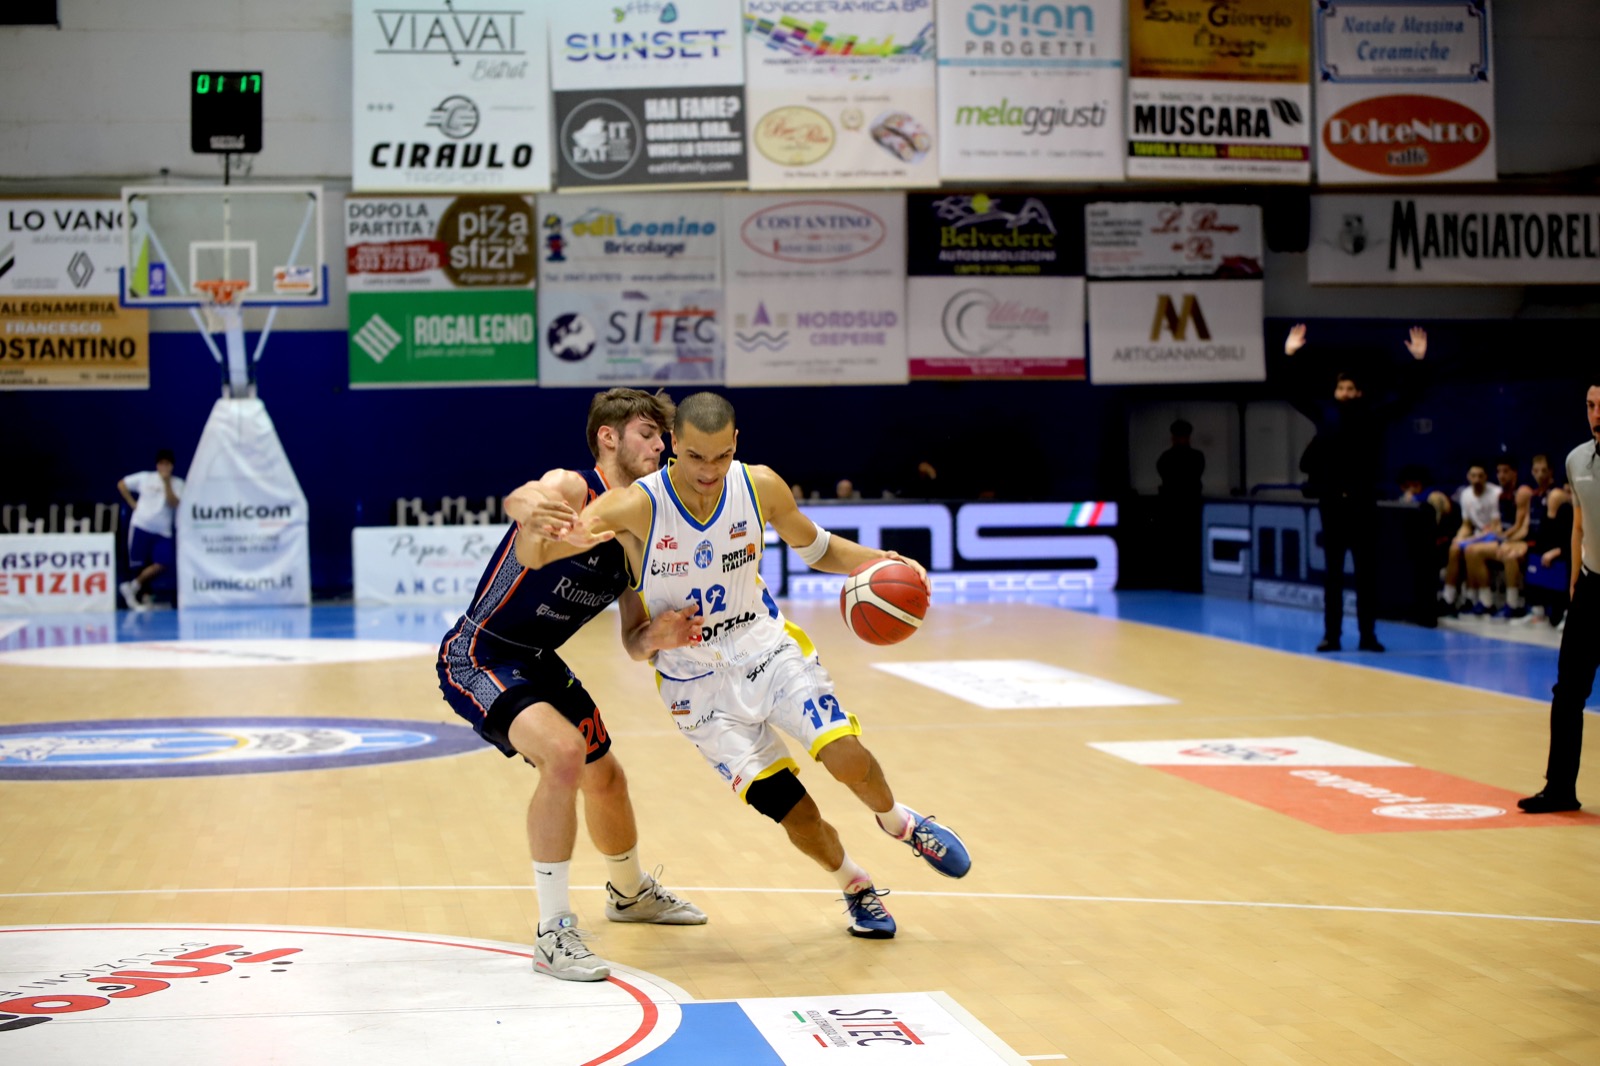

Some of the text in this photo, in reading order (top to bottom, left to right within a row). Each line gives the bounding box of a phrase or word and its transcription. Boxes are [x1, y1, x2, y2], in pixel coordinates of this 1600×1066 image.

[966, 0, 1095, 37] orion
[1208, 2, 1293, 34] Giorgio
[1341, 15, 1465, 34] Natale Messina
[377, 13, 517, 50] VIAVAI
[566, 29, 727, 62] SUNSET
[965, 41, 1097, 57] PROGETTI
[1356, 39, 1451, 61] Ceramiche
[644, 95, 741, 120] HAI FAME?
[955, 98, 1108, 135] melaggiusti
[1134, 104, 1271, 139] MUSCARA
[9, 211, 45, 231] LO
[349, 203, 429, 218] DOPO LA
[349, 220, 424, 236] PARTITA
[755, 215, 872, 230] COSTANTINO
[939, 226, 1056, 248] Belvedere
[1388, 200, 1600, 271] MANGIATOREL
[450, 239, 515, 269] sfizi
[603, 240, 687, 258] Bricolage
[0, 302, 117, 316] ALEGNAMERIA
[5, 322, 102, 335] FRANCESCO
[413, 313, 534, 347] ROGALEGNO
[606, 309, 718, 345] SITEC
[796, 312, 898, 329] NORDSUD
[809, 332, 887, 346] CREPERIE
[1112, 344, 1246, 363] ARTIGIANMOBILI
[191, 503, 292, 520] lumicom
[389, 533, 449, 565] Pepe
[0, 552, 111, 570] ASPORTI
[660, 561, 690, 573] SITEC
[192, 574, 294, 593] lumicom.it
[685, 583, 727, 616] 12
[802, 693, 847, 730] 12
[577, 706, 608, 755] 20
[828, 1008, 926, 1047] SITEC
